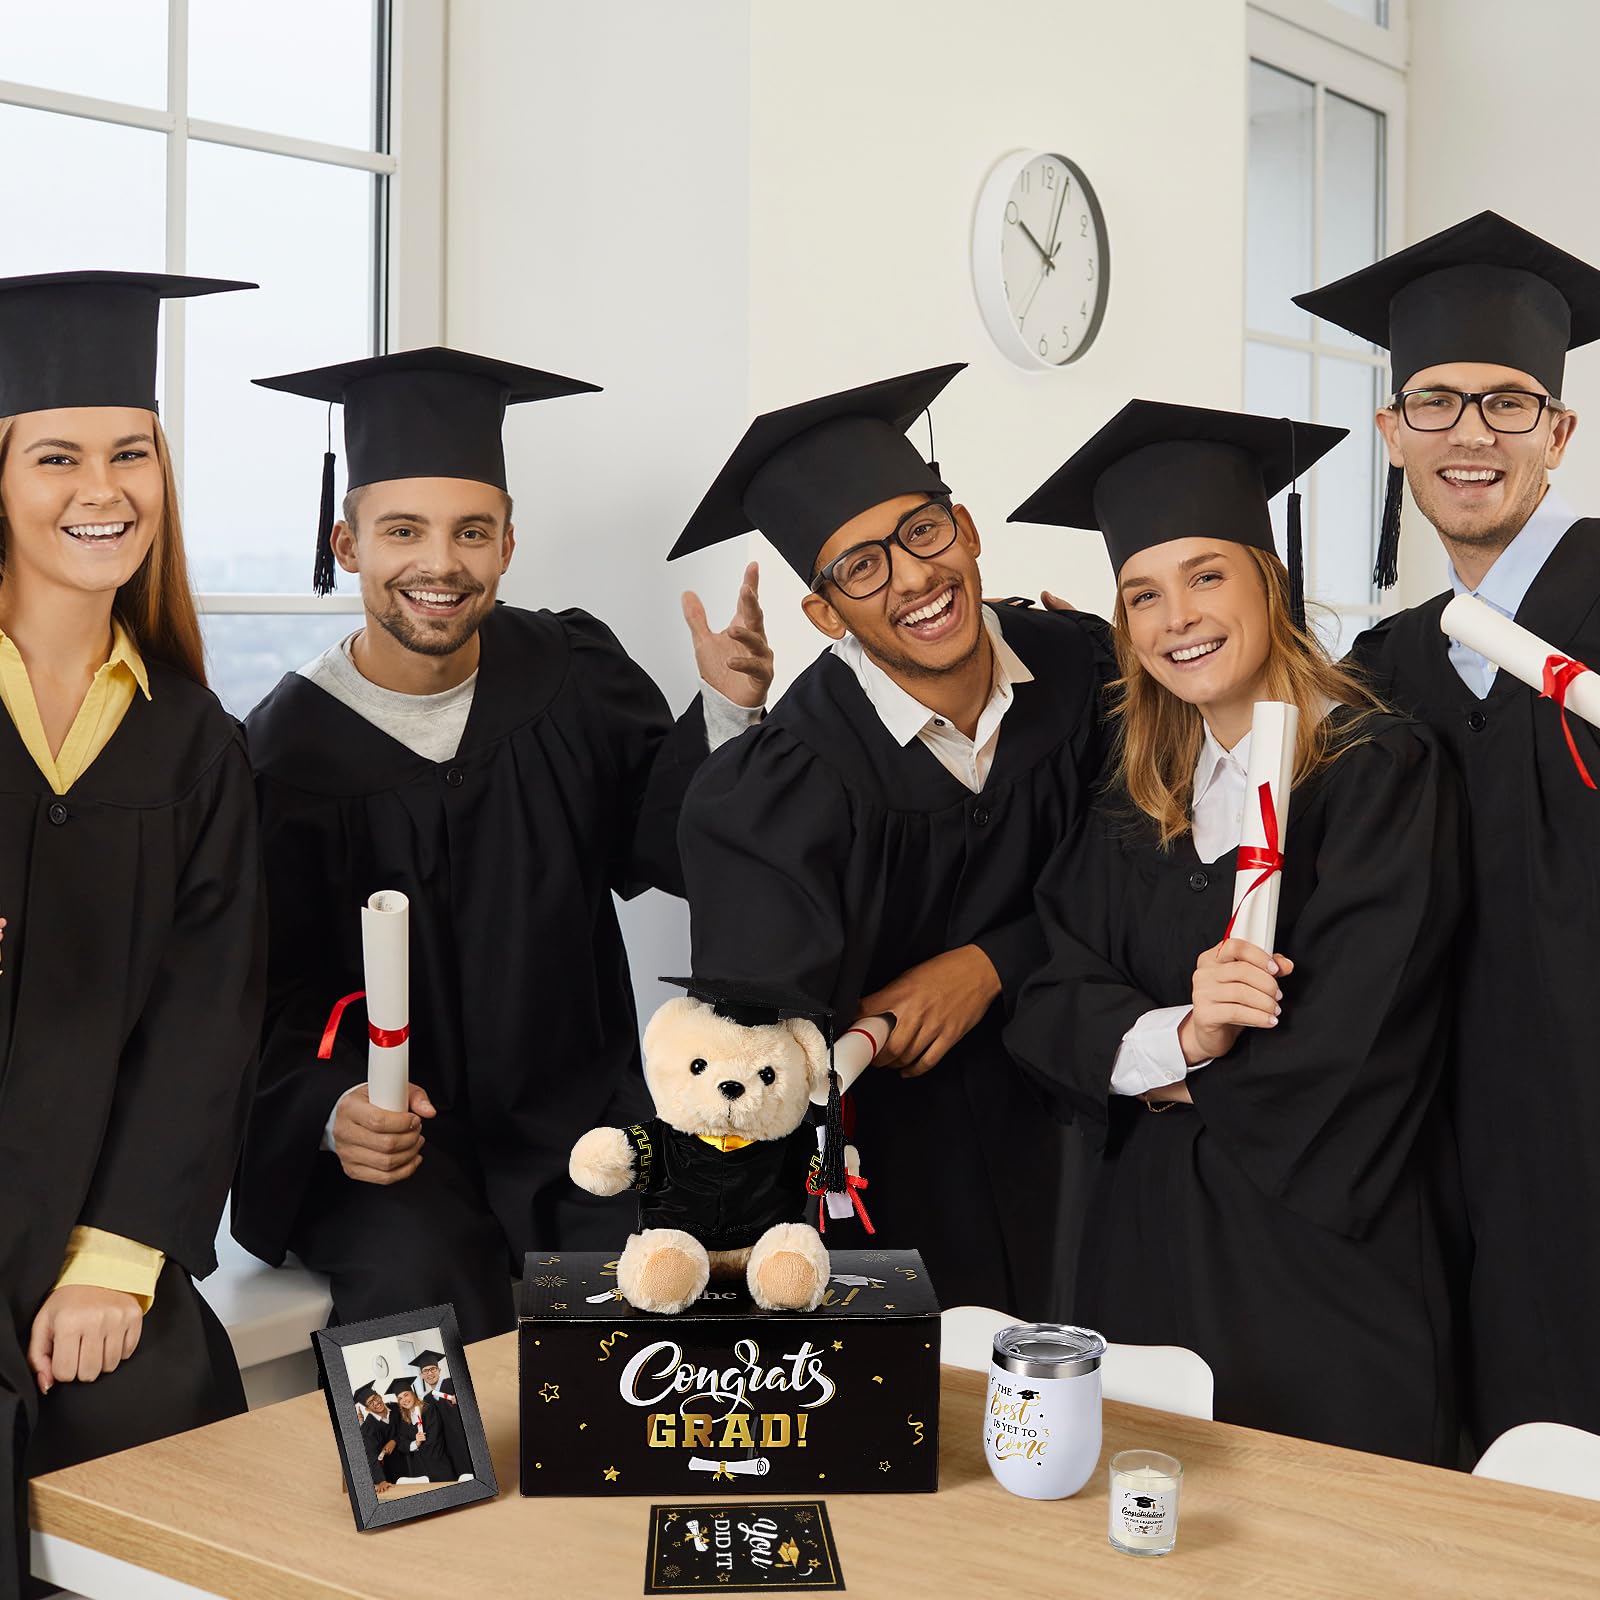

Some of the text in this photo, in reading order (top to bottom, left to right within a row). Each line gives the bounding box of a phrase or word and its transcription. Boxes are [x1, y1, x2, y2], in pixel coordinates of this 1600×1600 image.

[1021, 169, 1030, 194] 11
[1041, 164, 1054, 190] 12
[1080, 214, 1089, 238] 2
[1087, 258, 1095, 282] 3
[1038, 334, 1049, 357] 6
[1061, 326, 1069, 349] 5
[620, 1339, 836, 1424] Congrats
[997, 1383, 1013, 1397] THE
[990, 1390, 1040, 1426] Best
[647, 1413, 809, 1448] GRAD!
[993, 1418, 1037, 1438] IS YET TO
[714, 1519, 734, 1571] DID IT
[737, 1517, 779, 1570] You
